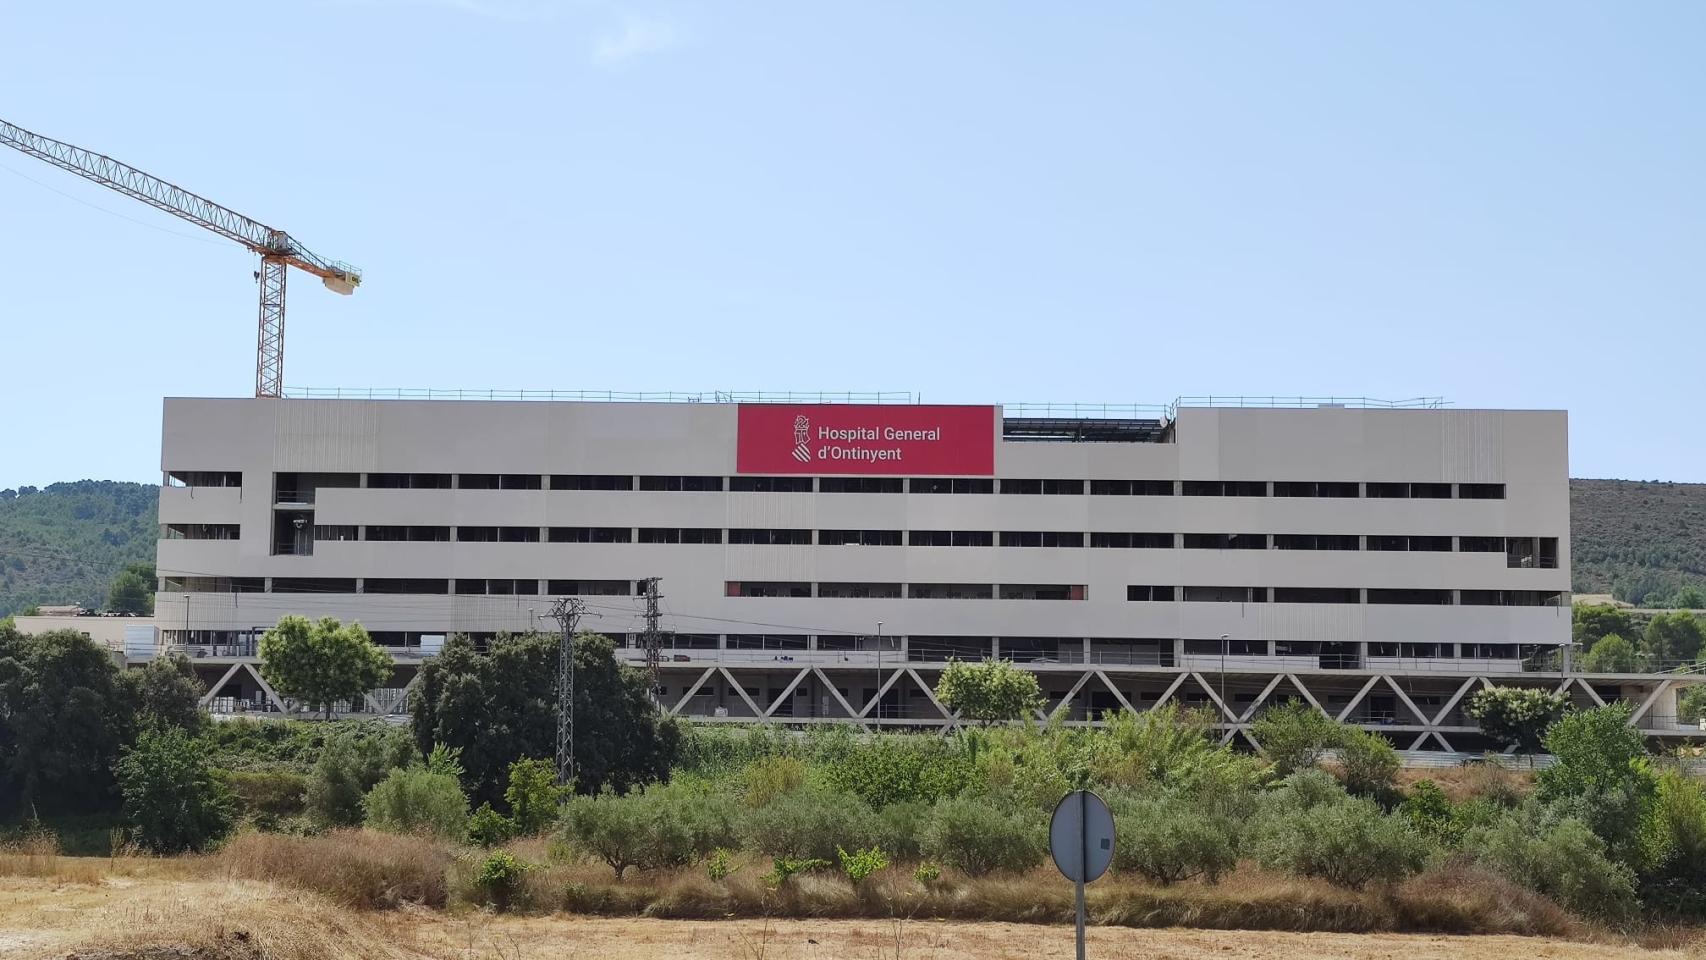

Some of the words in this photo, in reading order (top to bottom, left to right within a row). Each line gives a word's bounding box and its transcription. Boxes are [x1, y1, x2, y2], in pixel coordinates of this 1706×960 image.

[818, 426, 879, 443] Hospital
[884, 426, 940, 441] General
[818, 446, 902, 463] d’Ontinyent
